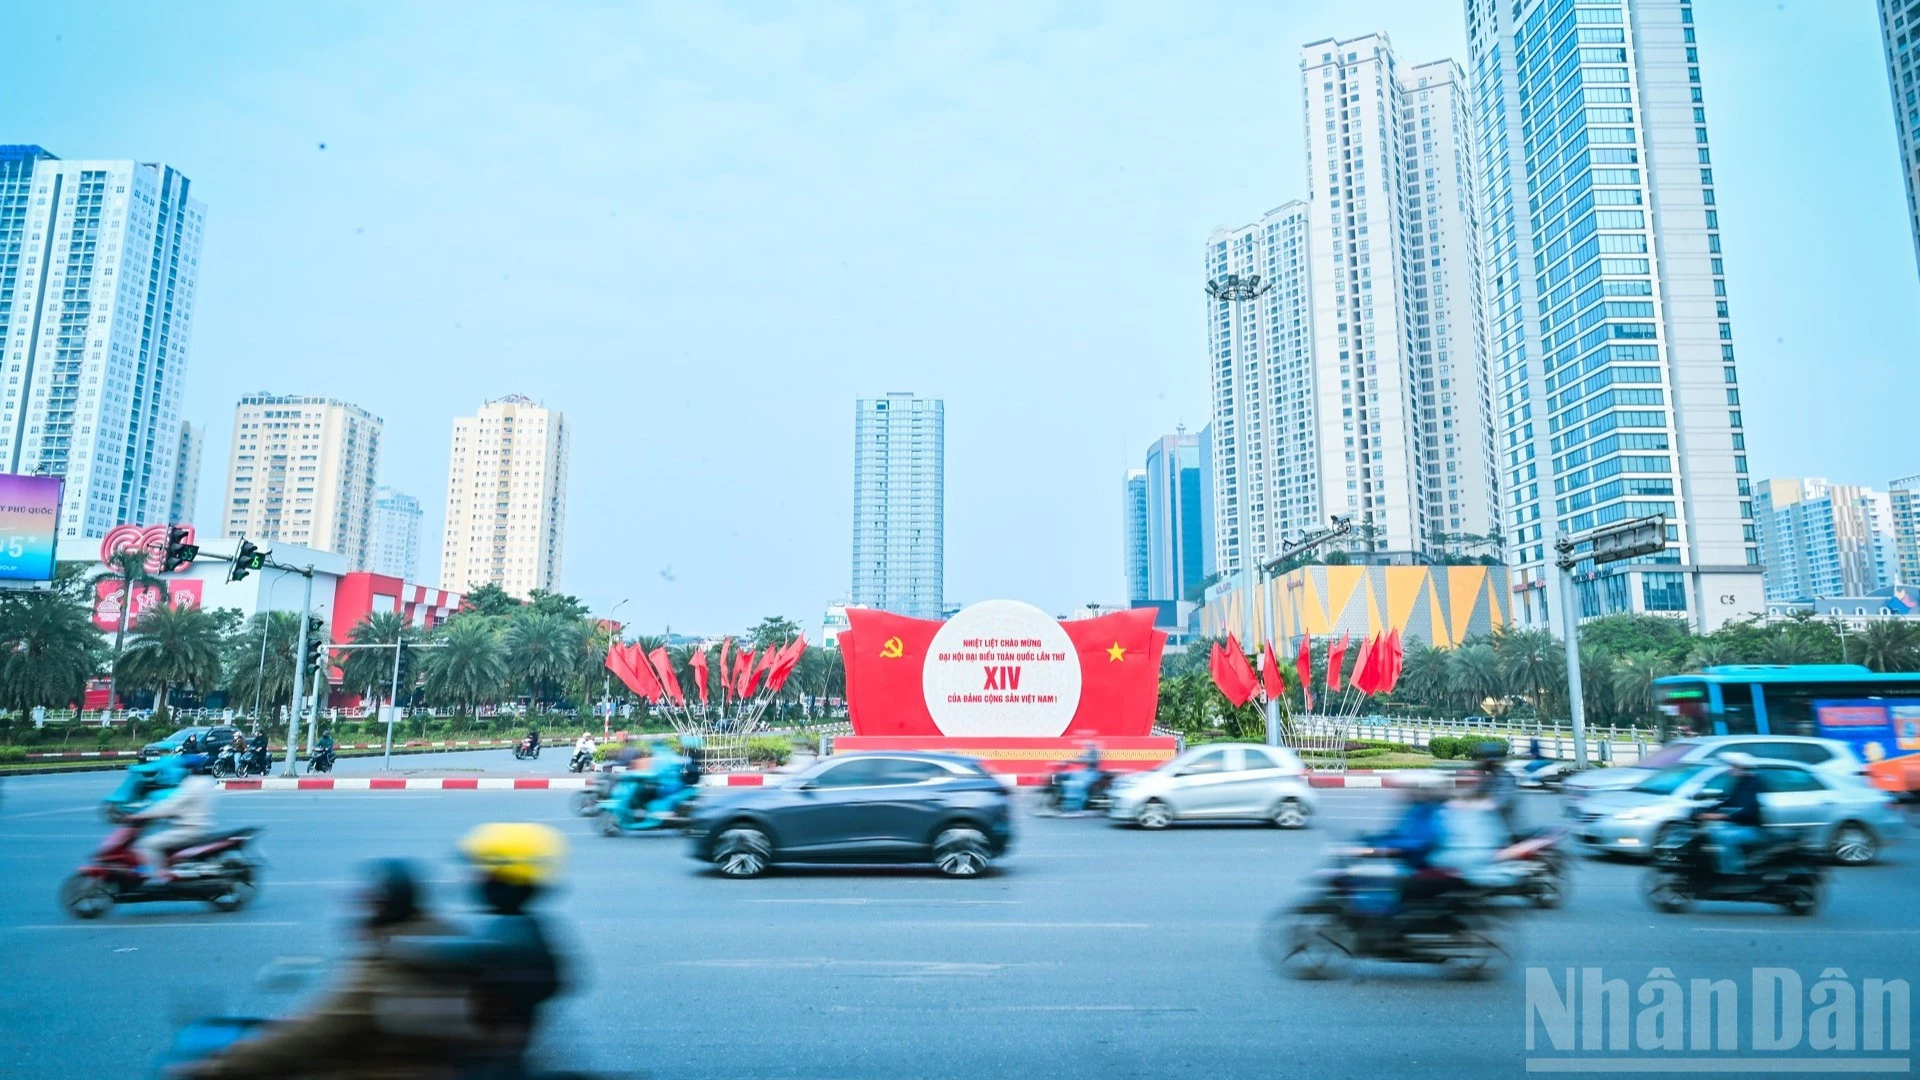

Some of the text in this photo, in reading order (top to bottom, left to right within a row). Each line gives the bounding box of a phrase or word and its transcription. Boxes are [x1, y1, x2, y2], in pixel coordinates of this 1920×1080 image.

[8, 505, 26, 513] PHÚ
[28, 506, 53, 515] QUỐC
[1720, 594, 1736, 605] C5
[963, 638, 1042, 649] NHIỆT LIỆT CHÀO MỪNG
[939, 653, 951, 662] ĐẠI
[952, 651, 964, 662] HỘI
[966, 653, 977, 662] ĐẠI
[980, 651, 995, 661] BIỂU
[997, 651, 1014, 661] TOÀN
[1016, 650, 1035, 662] QUỐC
[1051, 652, 1066, 661] THỨ
[983, 666, 1021, 690] XIV
[947, 692, 961, 703] CỦA
[963, 692, 982, 703] ĐẢNG
[984, 693, 1003, 704] CỘNG
[1005, 692, 1019, 703] SẢN
[1021, 693, 1036, 704] VIỆT
